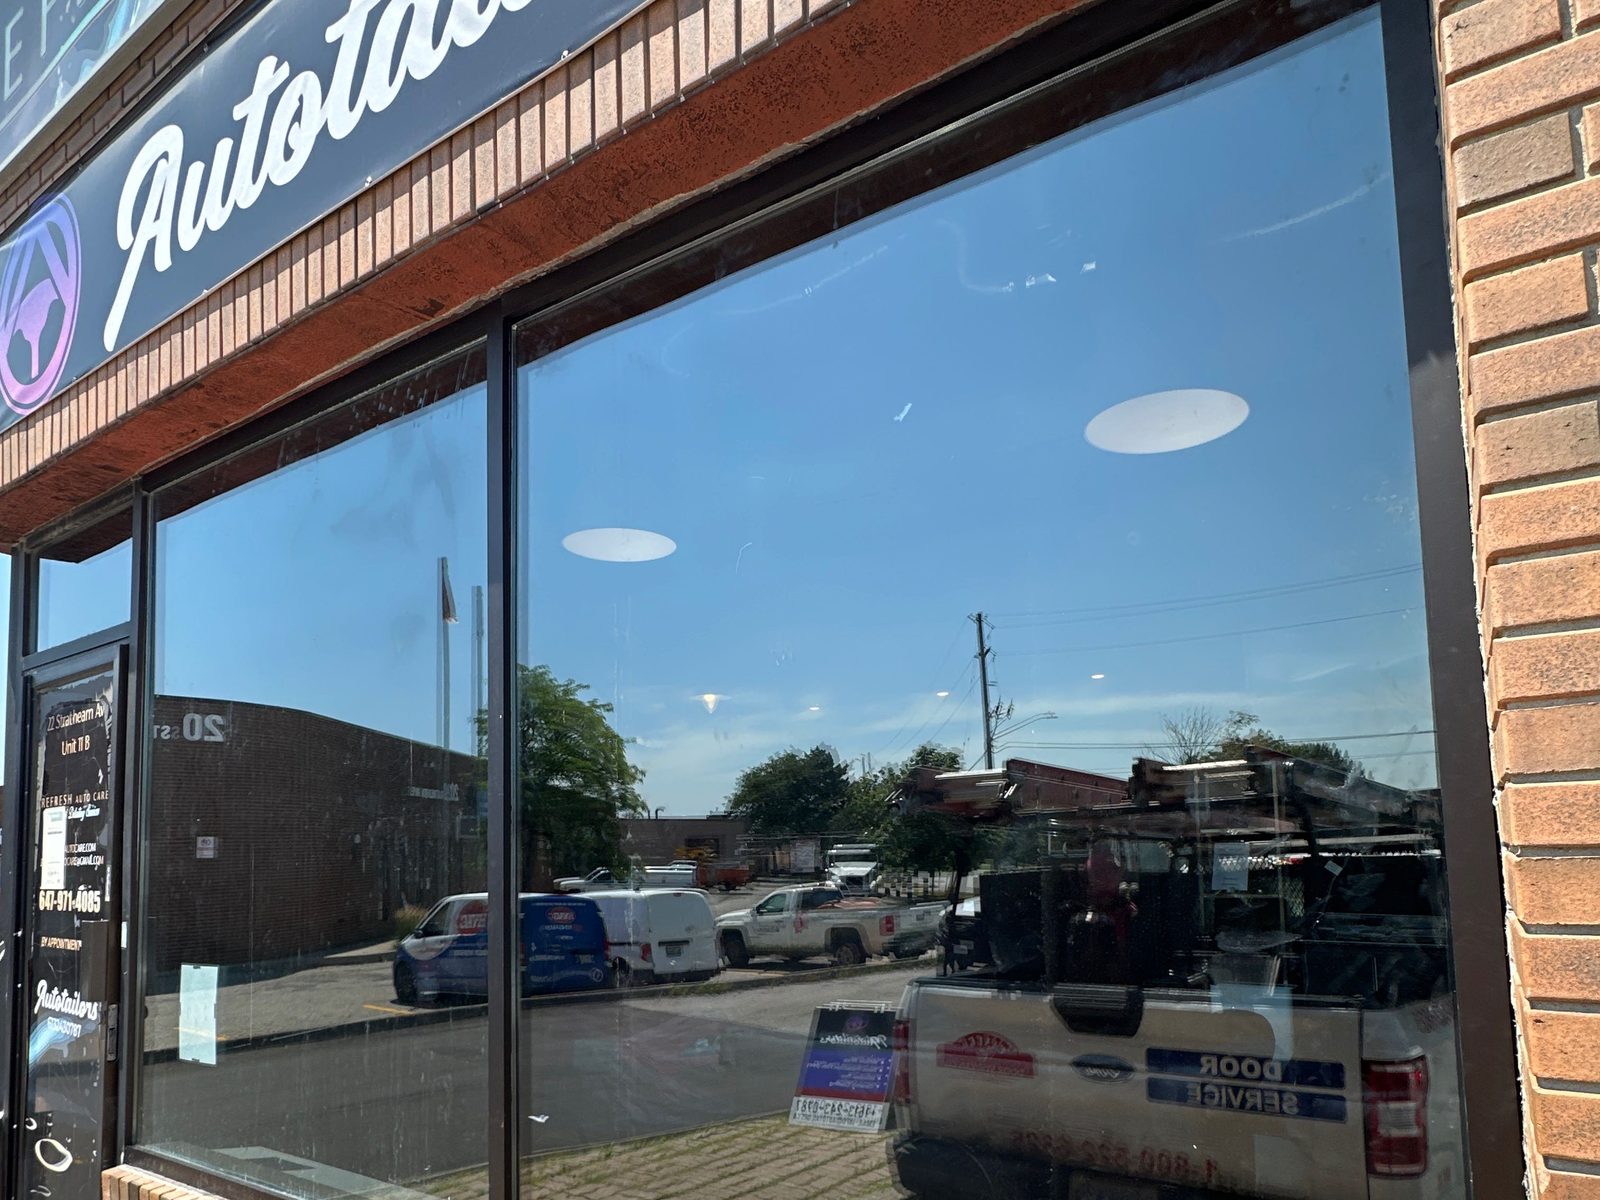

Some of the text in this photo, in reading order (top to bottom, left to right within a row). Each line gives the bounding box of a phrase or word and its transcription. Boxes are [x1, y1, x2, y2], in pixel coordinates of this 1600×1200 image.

[103, 0, 531, 352] Autota
[47, 715, 55, 731] 22
[95, 702, 104, 718] Av
[61, 738, 77, 756] Unit
[42, 790, 109, 808] REFRESH AUTO CARE
[39, 890, 101, 913] 647-971-4085
[34, 979, 98, 1021] Autotailors
